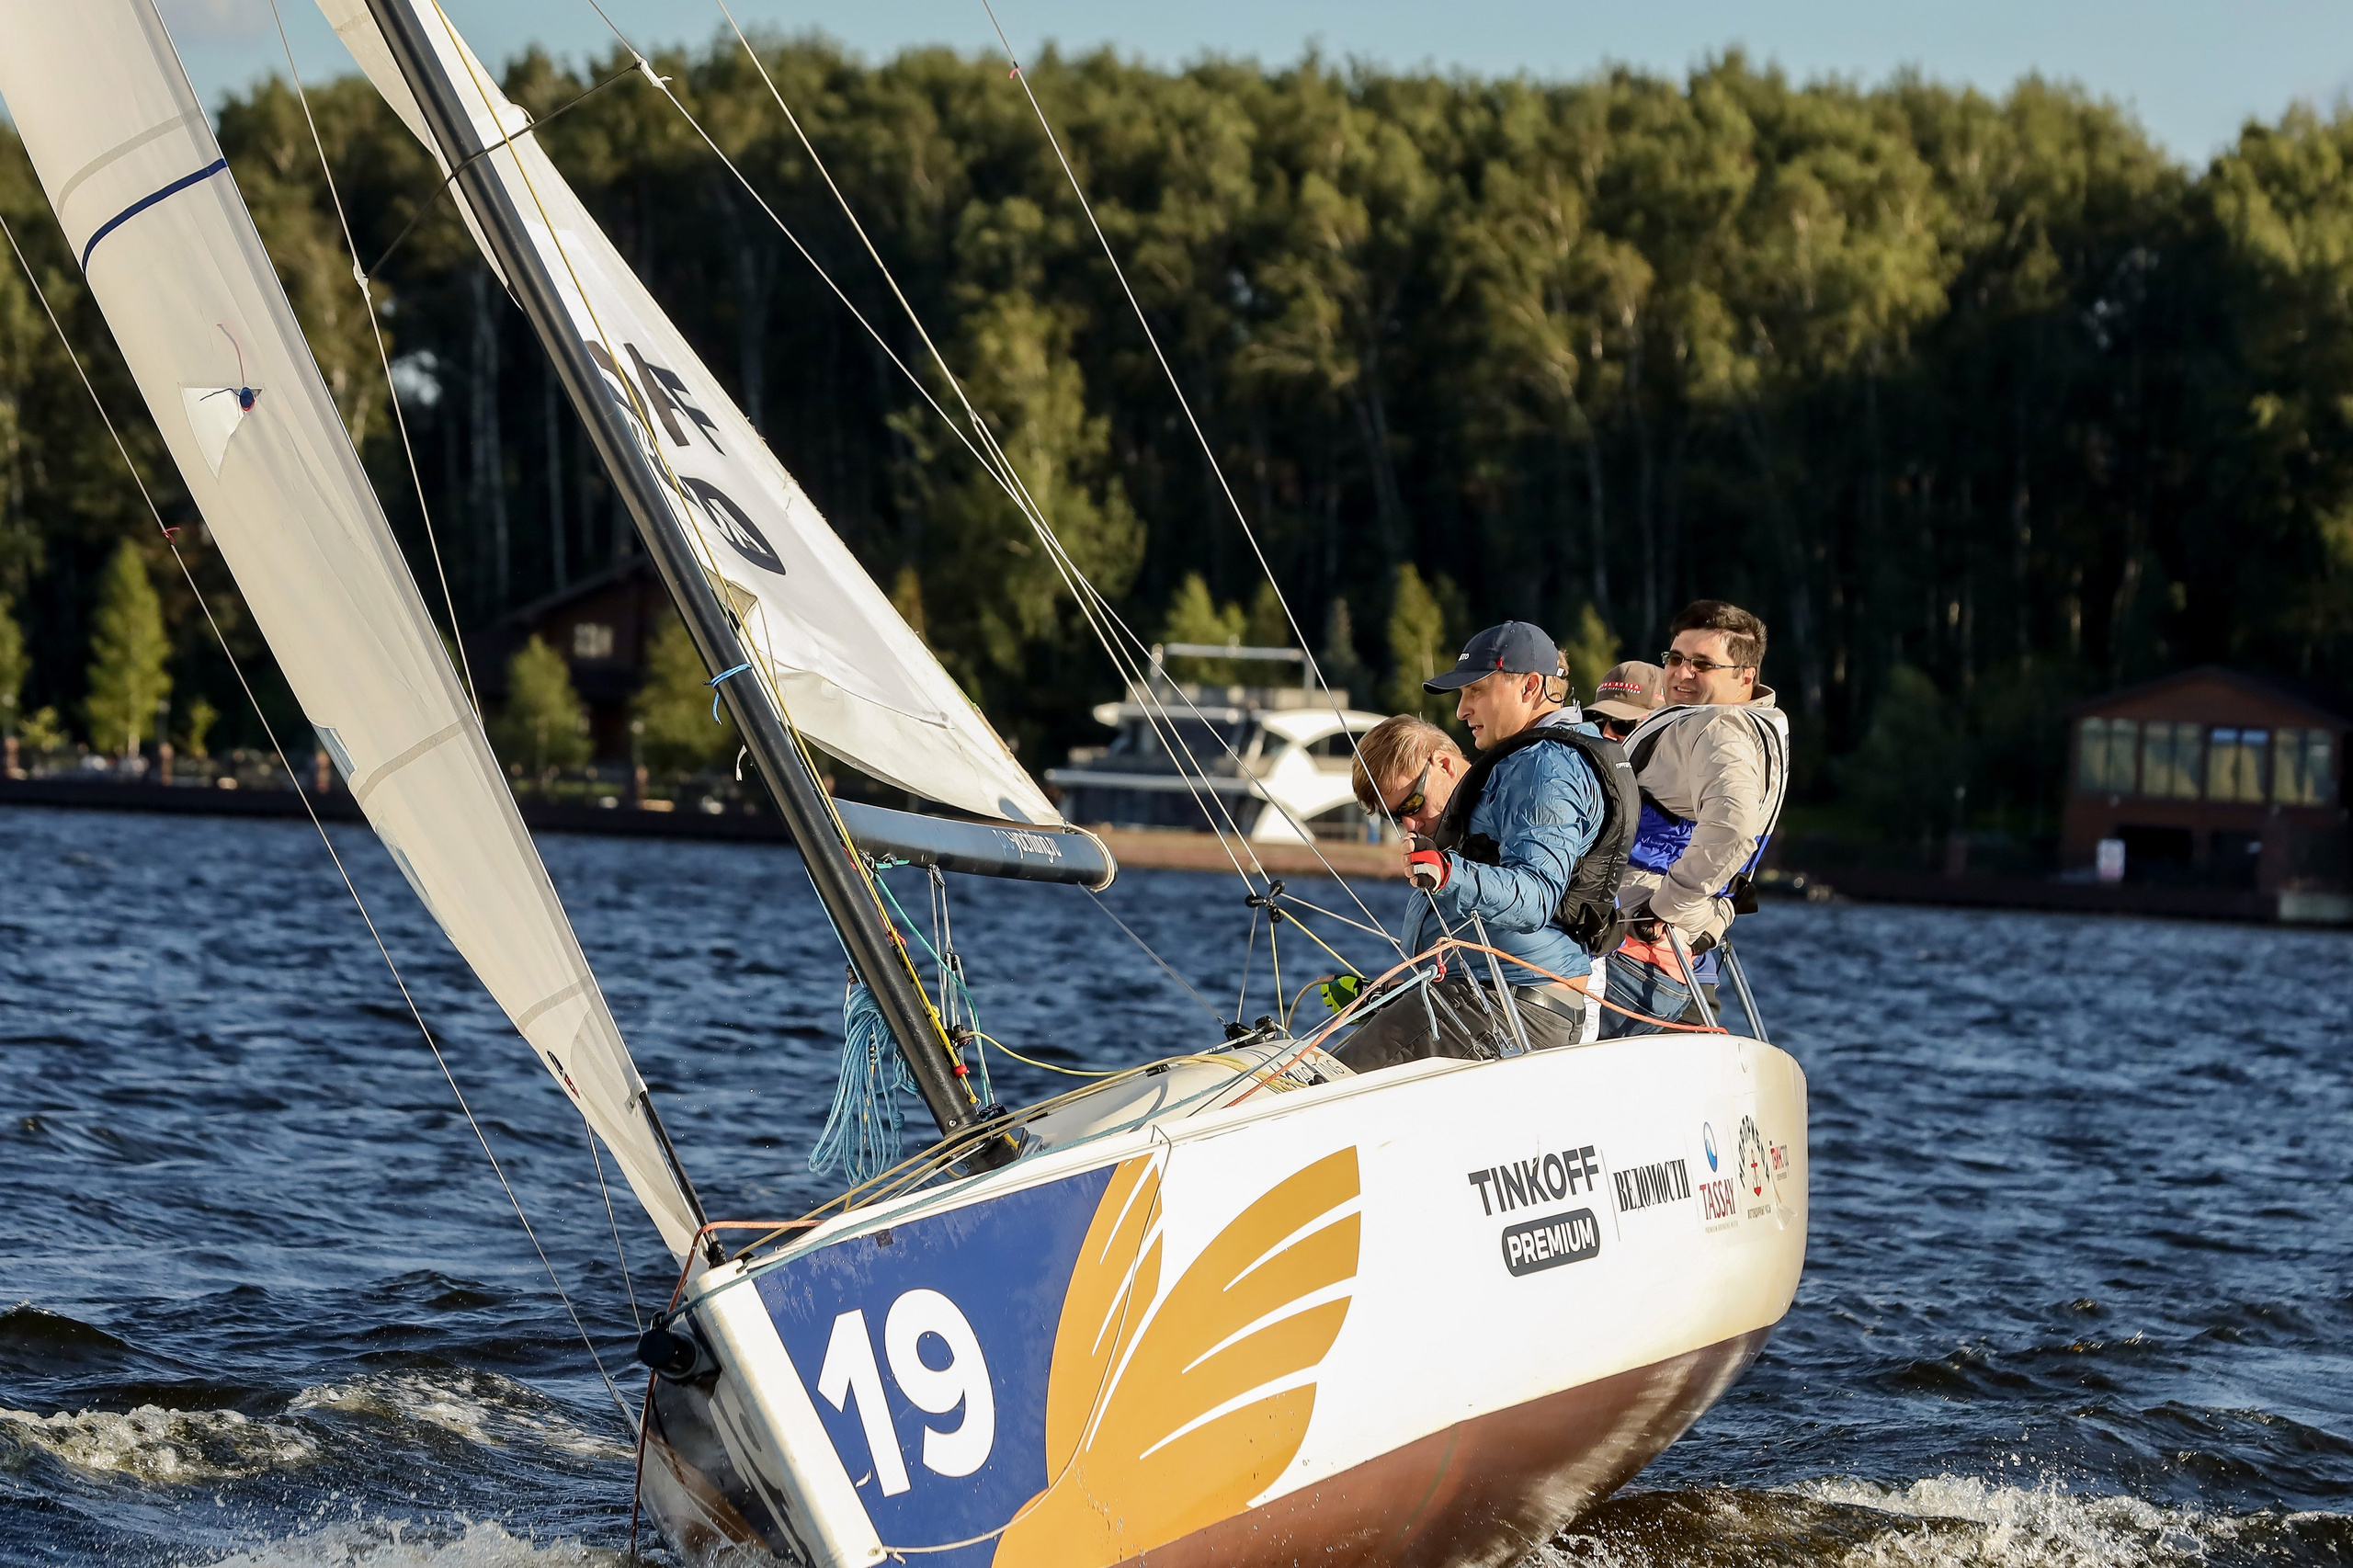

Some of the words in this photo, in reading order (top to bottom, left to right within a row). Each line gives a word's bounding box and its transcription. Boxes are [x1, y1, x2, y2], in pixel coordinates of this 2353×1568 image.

[1614, 682, 1640, 690] ROSSA
[1467, 1144, 1600, 1217] TINKOFF
[1612, 1158, 1692, 1213] ВЕДОМОСТИ
[1699, 1176, 1736, 1221] TASSAY
[1506, 1216, 1597, 1268] PREMIUM
[816, 1288, 996, 1498] 19
